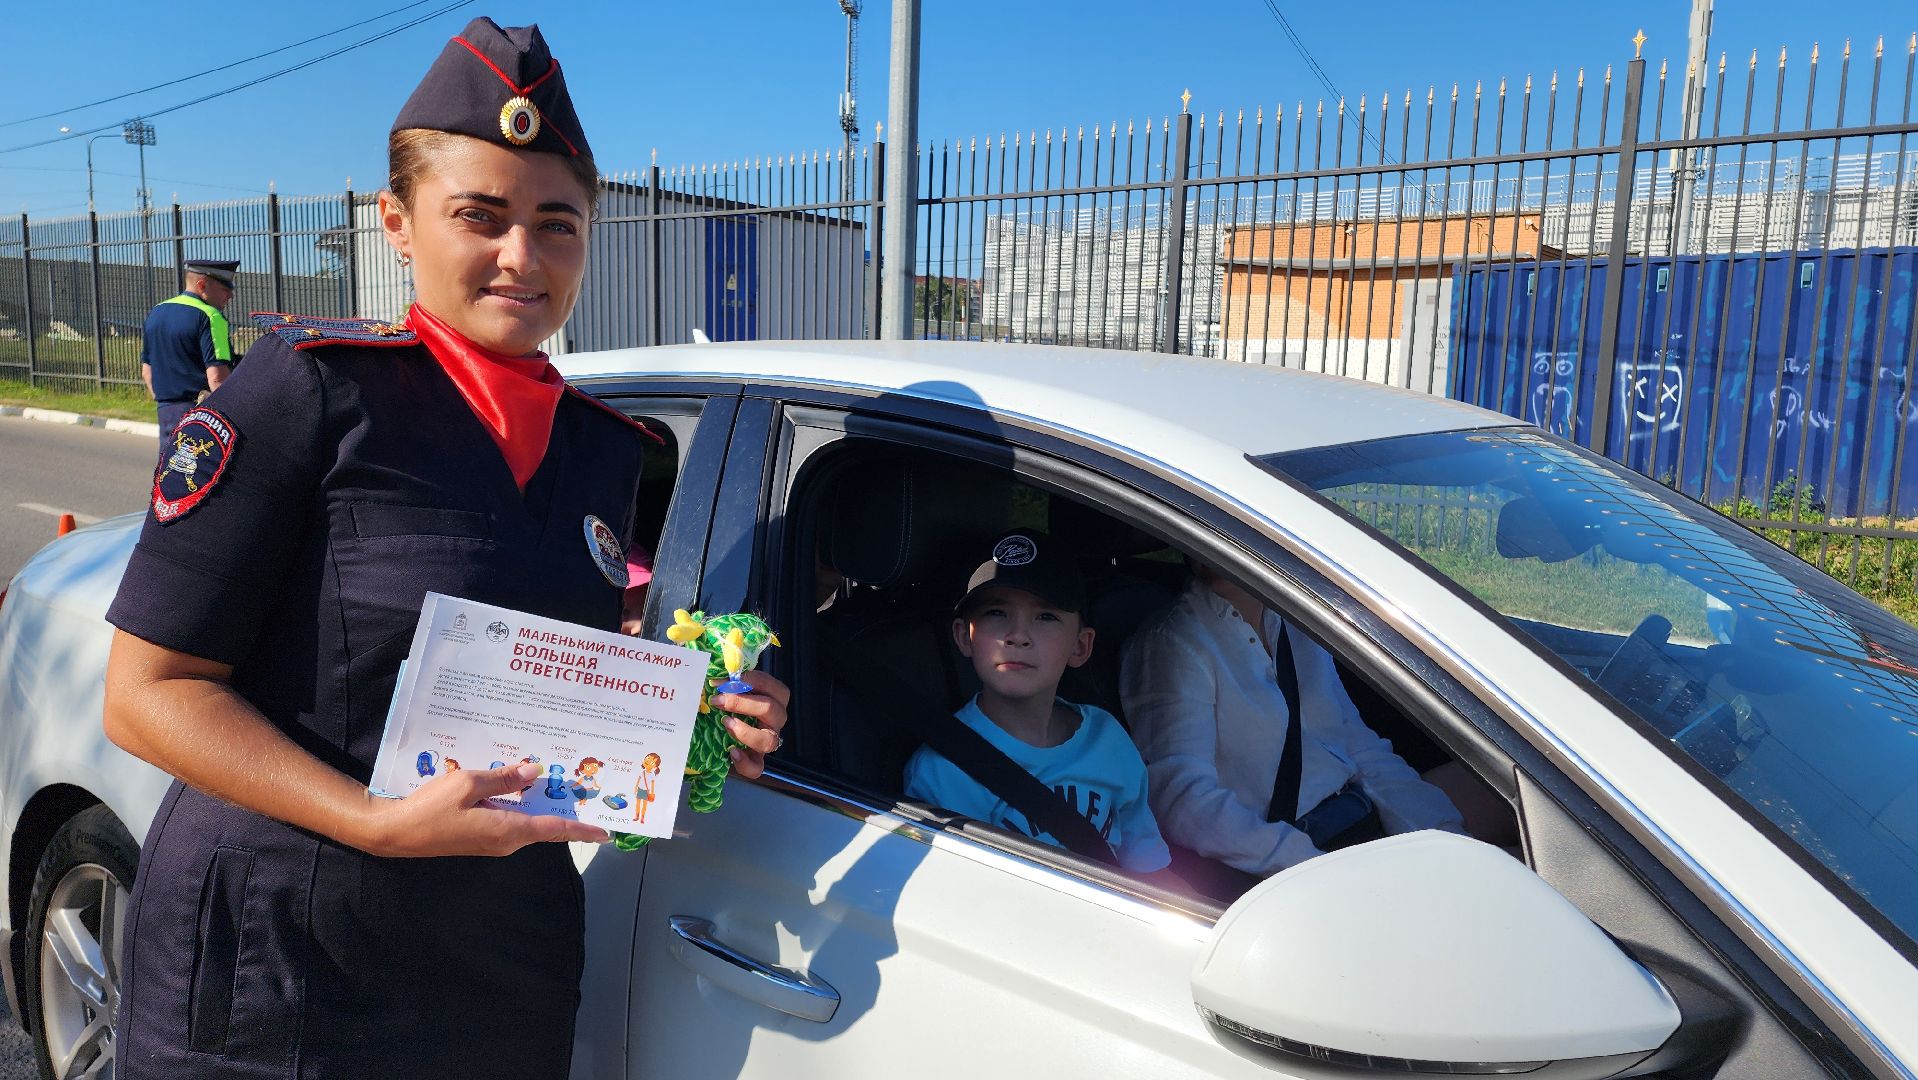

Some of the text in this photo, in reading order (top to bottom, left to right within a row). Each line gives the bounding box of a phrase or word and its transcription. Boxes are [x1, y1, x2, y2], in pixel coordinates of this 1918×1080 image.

[513, 642, 599, 670] БОЛЬШАЯ
[518, 627, 605, 655] МАЛЕНЬКИЙ
[607, 645, 682, 669] ПАССАЖИР
[509, 658, 676, 701] ОТВЕТСТВЕННОСТЬ!
